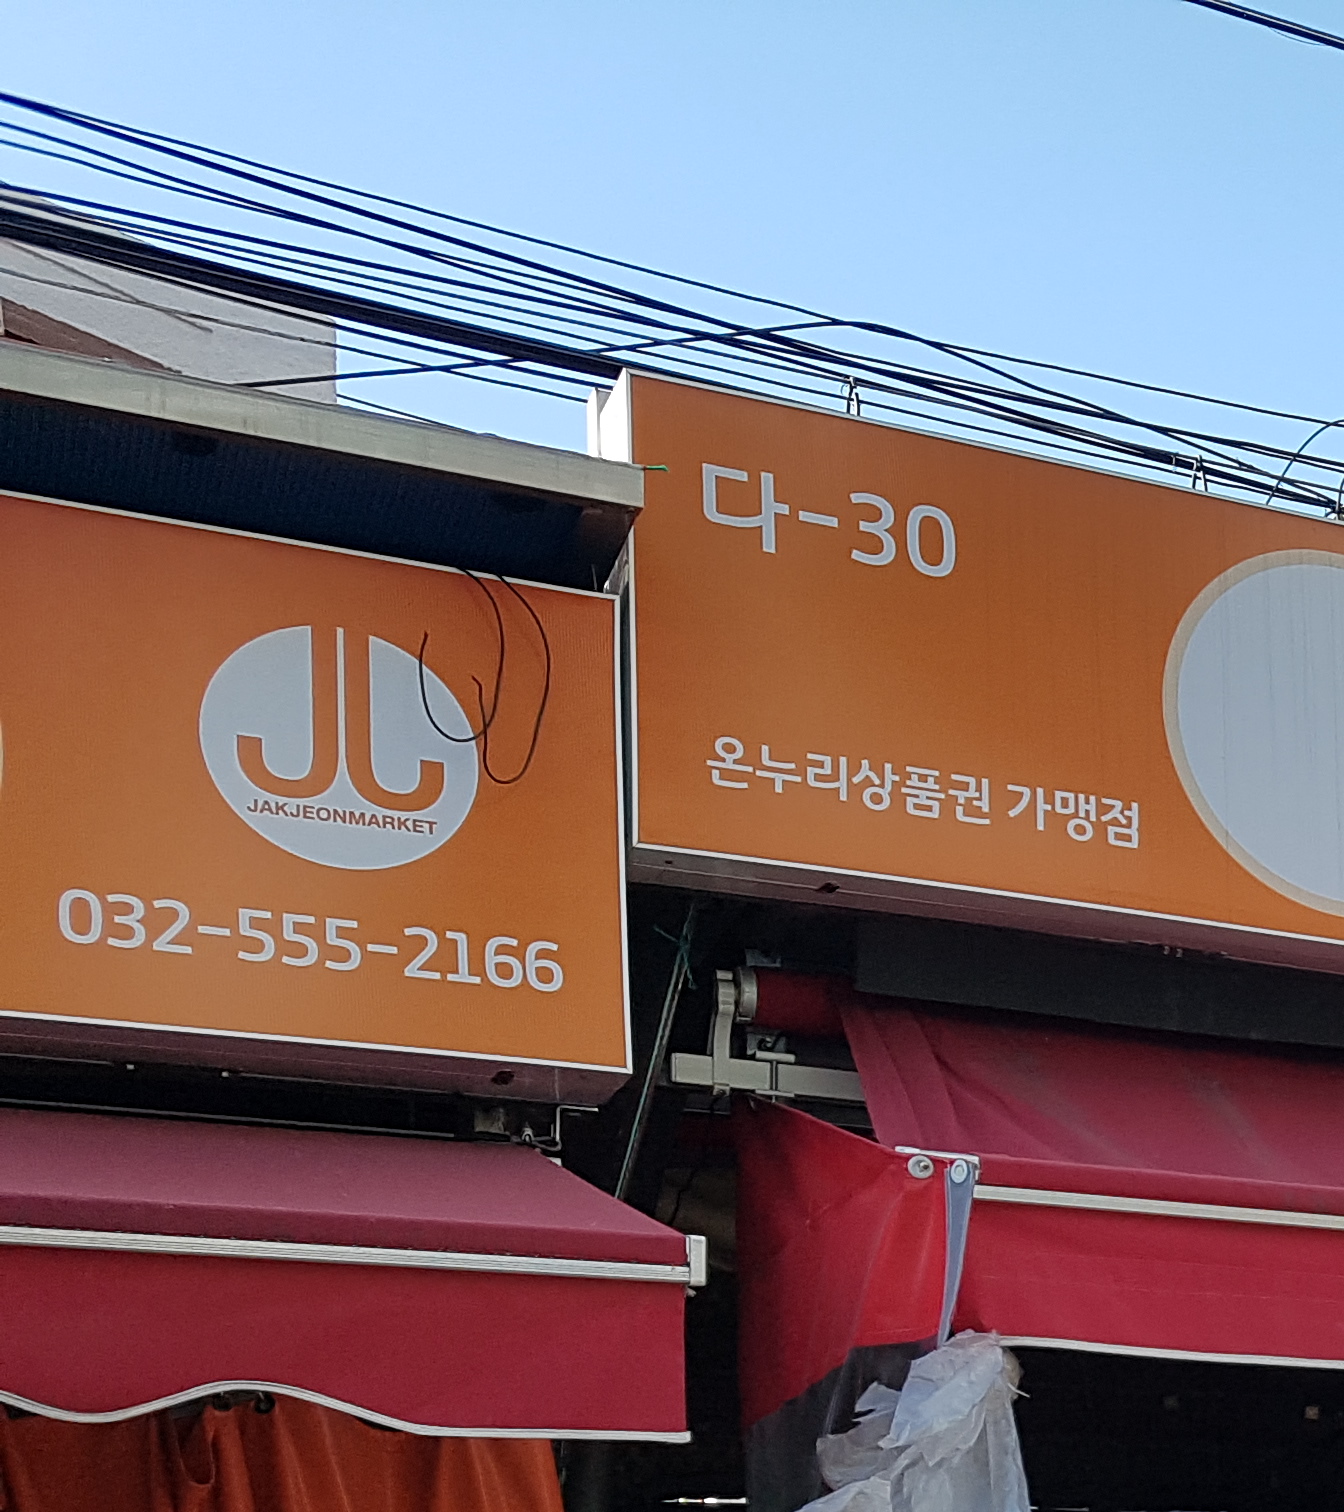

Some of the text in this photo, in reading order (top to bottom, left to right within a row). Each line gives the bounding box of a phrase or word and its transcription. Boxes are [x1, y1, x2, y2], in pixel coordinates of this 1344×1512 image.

[701, 461, 957, 578] 다-30
[245, 797, 438, 836] JAKJEONMARKET
[705, 735, 1140, 850] 온누리상품권 가맹점
[57, 888, 564, 992] 032-555-2166
